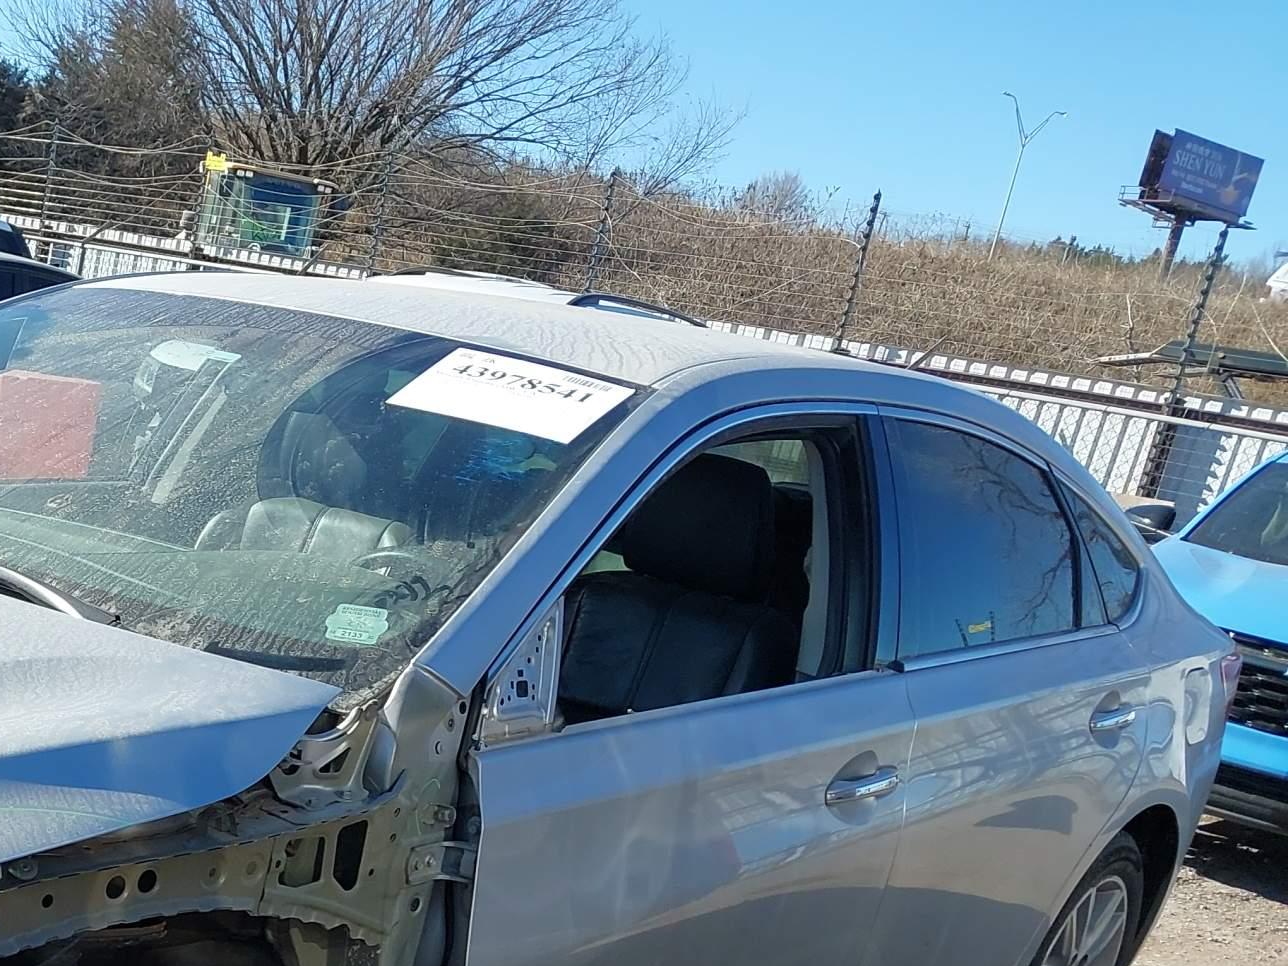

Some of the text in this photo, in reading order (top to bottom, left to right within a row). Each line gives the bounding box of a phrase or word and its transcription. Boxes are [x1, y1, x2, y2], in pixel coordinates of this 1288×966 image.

[1173, 150, 1203, 171] SHEN
[1204, 159, 1226, 179] YUN
[452, 364, 593, 403] 43978541
